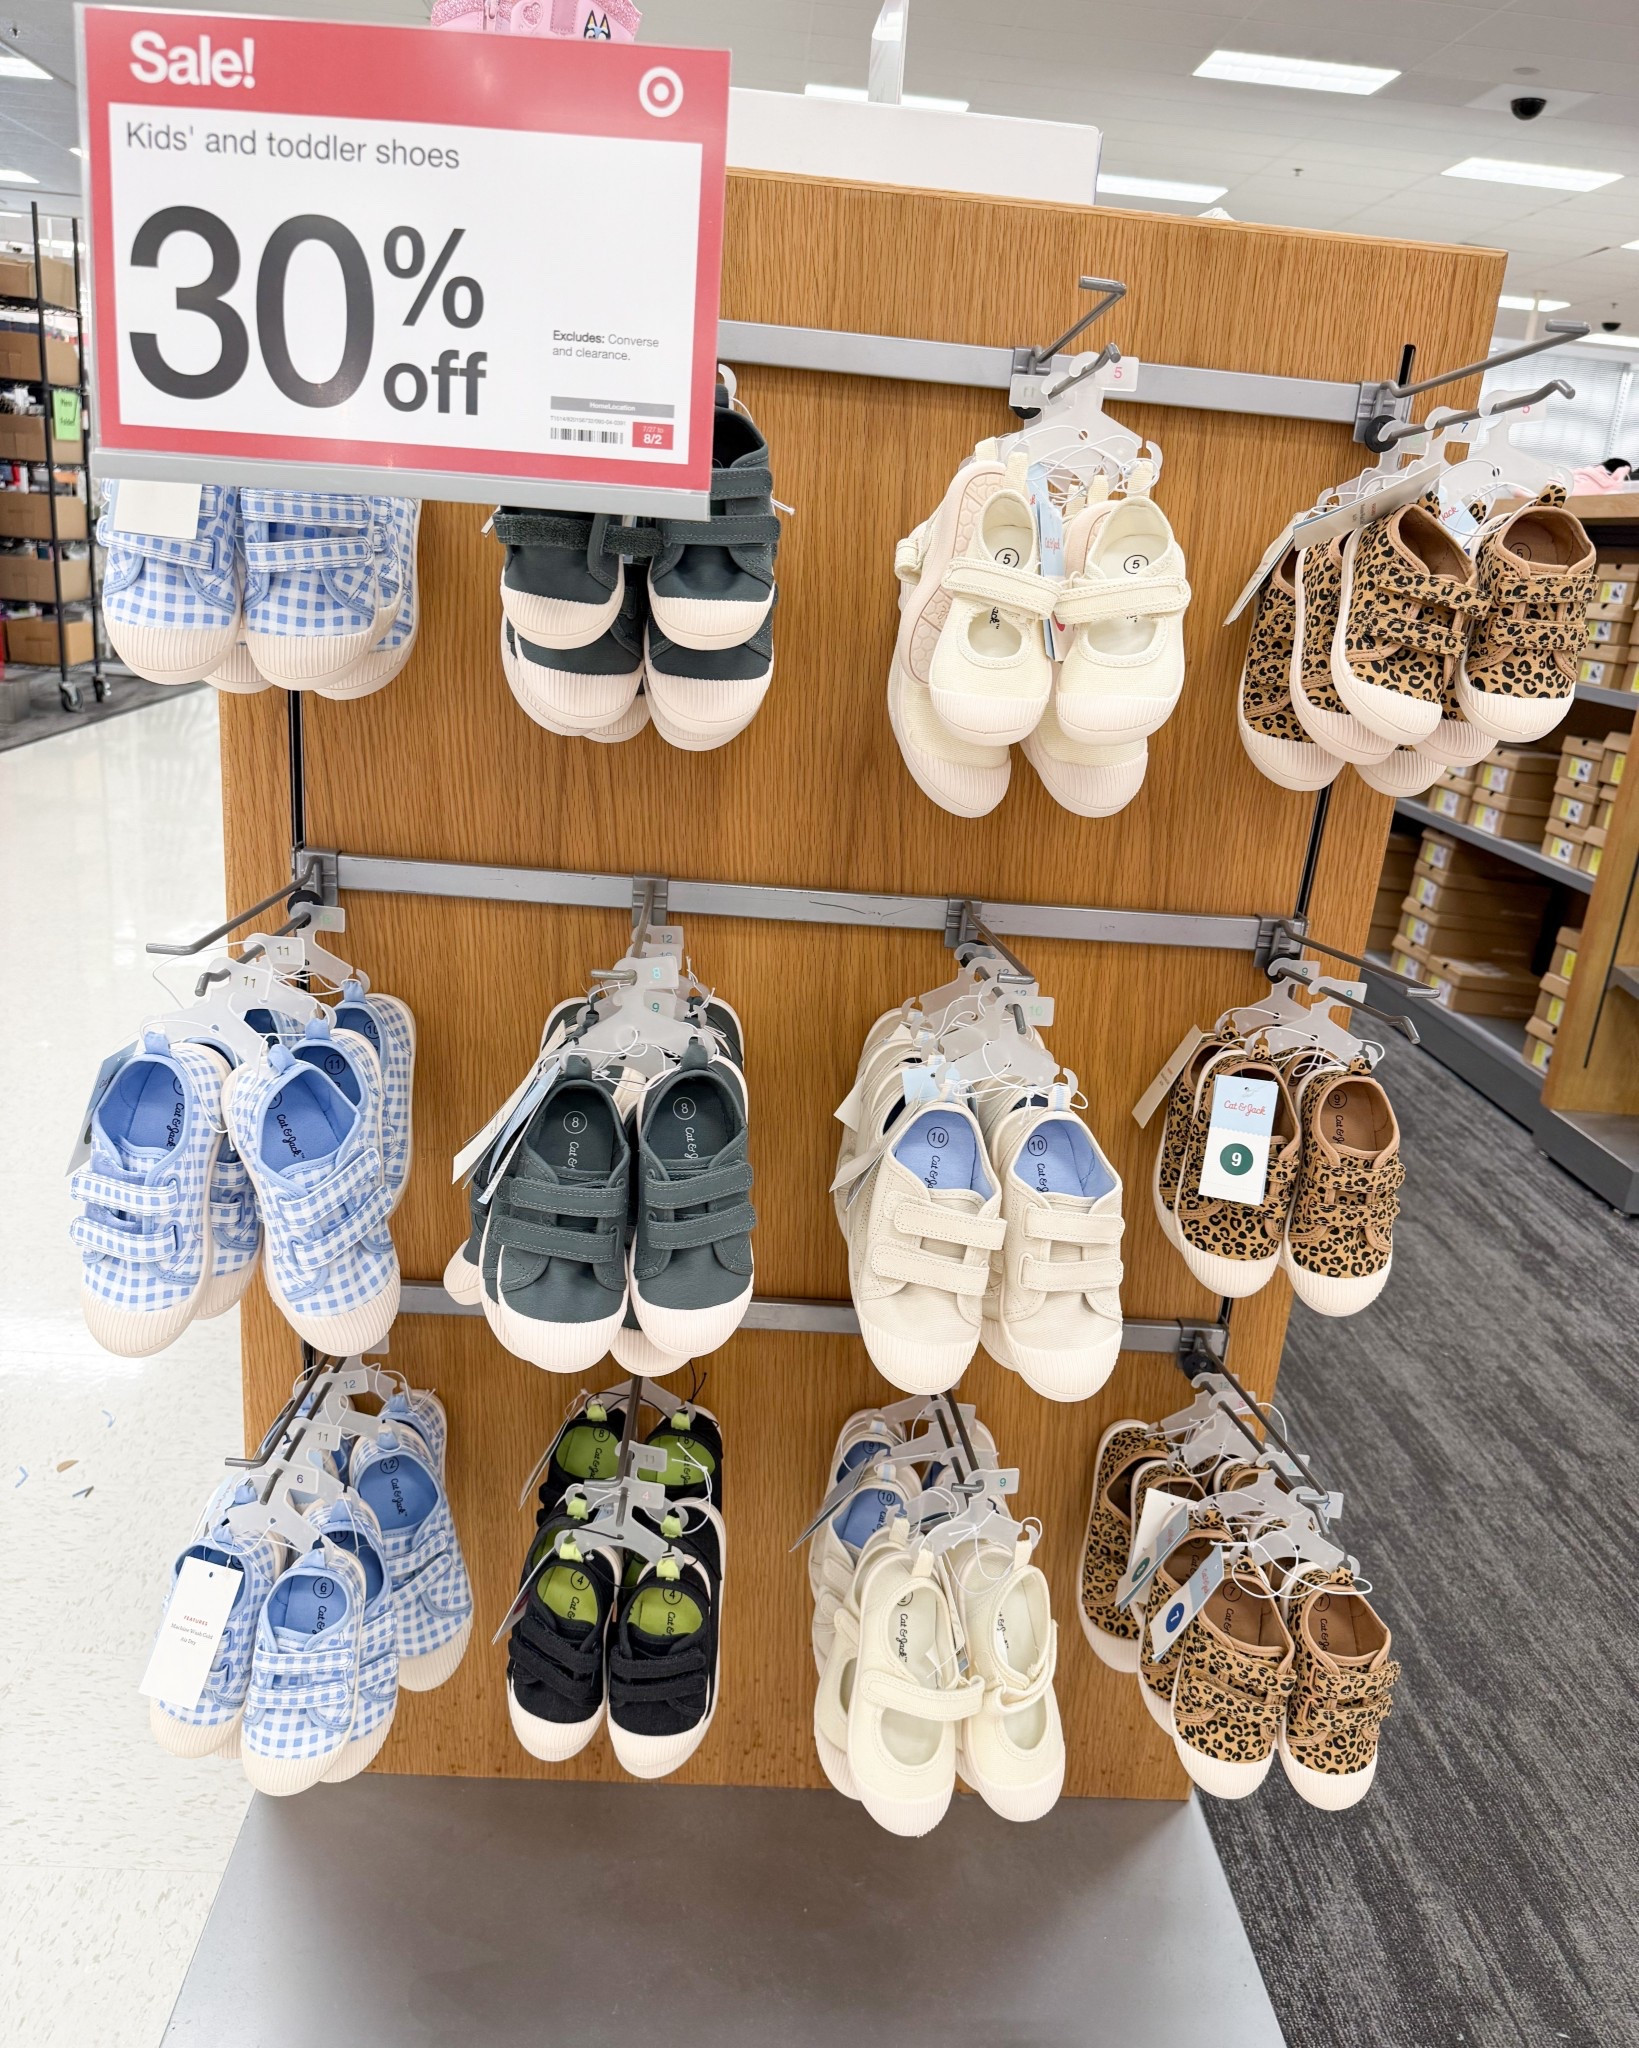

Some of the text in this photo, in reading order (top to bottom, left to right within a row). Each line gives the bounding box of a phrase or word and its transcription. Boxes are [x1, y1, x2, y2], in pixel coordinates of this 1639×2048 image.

[130, 29, 256, 90] Sale!
[126, 120, 461, 170] Kids' and toddler shoes
[552, 329, 660, 348] Excludes: Converse
[552, 347, 631, 361] and clearance.
[1113, 366, 1123, 379] 5
[382, 350, 488, 417] off
[1461, 421, 1469, 433] 7
[643, 433, 663, 445] 8/2
[1003, 553, 1012, 565] 5
[1132, 559, 1141, 570] 5
[660, 934, 673, 944] 12
[276, 945, 290, 956] 11
[243, 975, 256, 989] 11
[651, 1002, 660, 1013] 9
[329, 1059, 341, 1070] 11
[173, 1102, 185, 1117] Cat
[680, 1102, 689, 1114] 8
[1223, 1099, 1266, 1117] Cat & Jack
[276, 1113, 289, 1129] Cat
[571, 1116, 580, 1128] 8
[684, 1126, 695, 1142] Cat
[931, 1131, 945, 1144] 10
[568, 1141, 580, 1157] Cat
[1031, 1139, 1044, 1151] 10
[930, 1155, 941, 1170] Cat
[1231, 1151, 1243, 1167] 9
[1036, 1162, 1046, 1177] Cat
[343, 1379, 356, 1389] 12
[317, 1431, 329, 1442] 11
[383, 1459, 397, 1470] 12
[296, 1474, 304, 1484] 6
[999, 1477, 1007, 1488] 9
[881, 1491, 892, 1502] 10
[577, 1575, 585, 1586] 4
[319, 1581, 328, 1594] 6
[1229, 1586, 1236, 1596] 7
[669, 1590, 676, 1600] 4
[569, 1596, 580, 1611] Cat
[317, 1605, 327, 1620] Cat
[667, 1611, 676, 1625] Cat
[1170, 1610, 1180, 1622] 7
[1224, 1608, 1235, 1622] Cat
[899, 1613, 909, 1627] Cat
[1320, 1618, 1328, 1633] Cat
